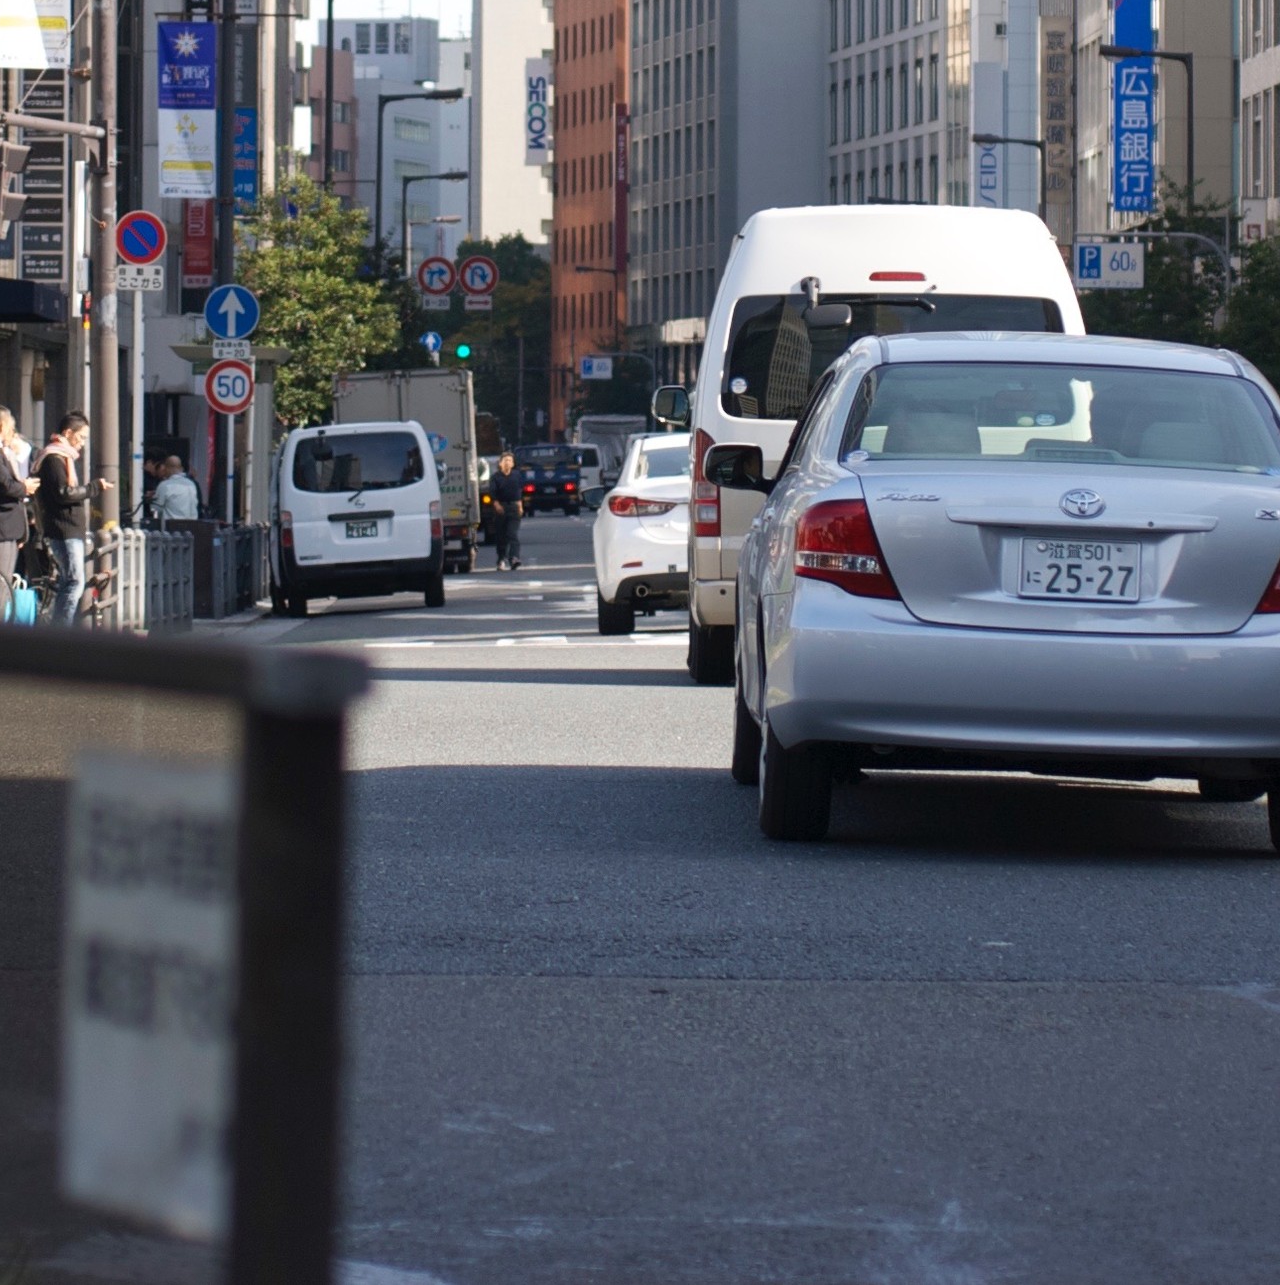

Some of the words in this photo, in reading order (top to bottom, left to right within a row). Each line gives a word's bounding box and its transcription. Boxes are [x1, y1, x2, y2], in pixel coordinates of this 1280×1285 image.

[528, 76, 547, 150] SECOM
[1045, 30, 1067, 191] 京阪淀屋橋ビル
[1120, 66, 1150, 193] 広島銀行
[118, 277, 162, 289] ここから
[217, 375, 245, 398] 50
[1026, 570, 1042, 584] に
[1045, 563, 1134, 596] 25-27
